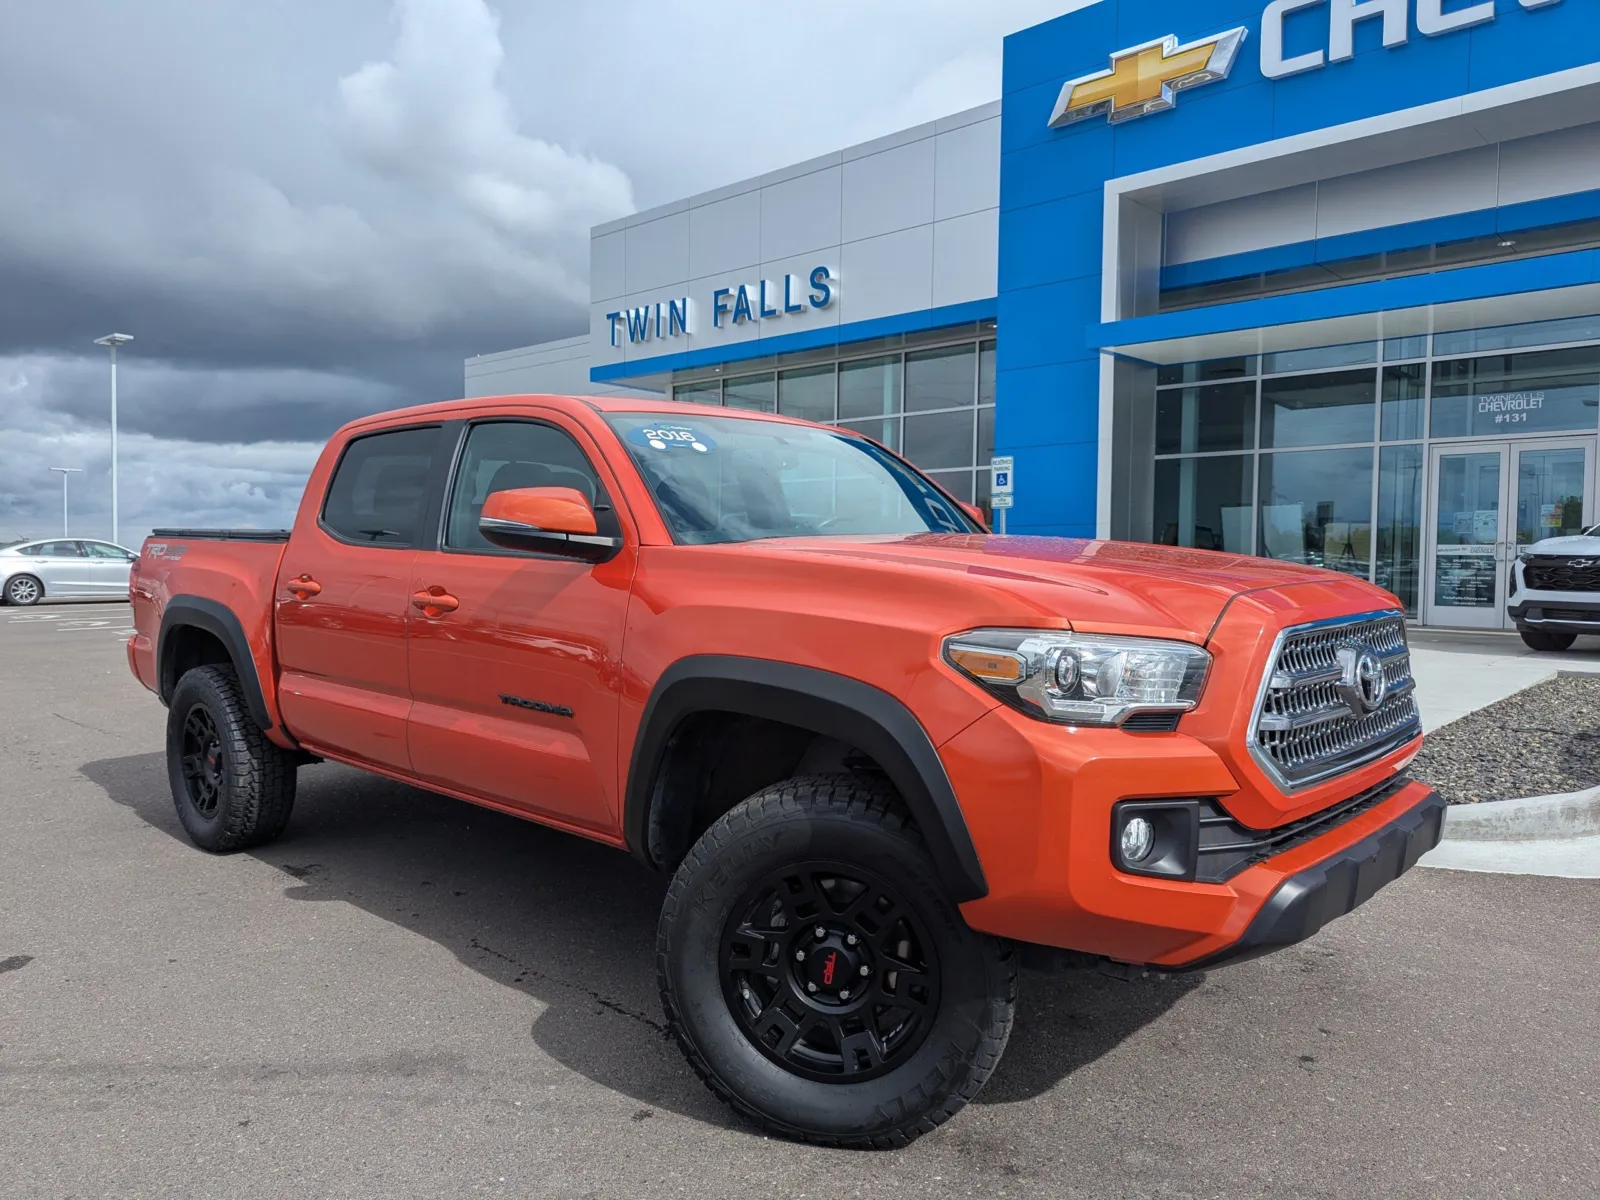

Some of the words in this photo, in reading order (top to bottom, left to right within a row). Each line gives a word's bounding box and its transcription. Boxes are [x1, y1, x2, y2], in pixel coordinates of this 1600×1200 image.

[606, 296, 690, 347] TWIN
[713, 266, 833, 328] FALLS
[1478, 399, 1543, 413] CHEVROLET
[1494, 412, 1527, 424] #131
[497, 692, 574, 718] TACOMA
[823, 951, 837, 985] TRD
